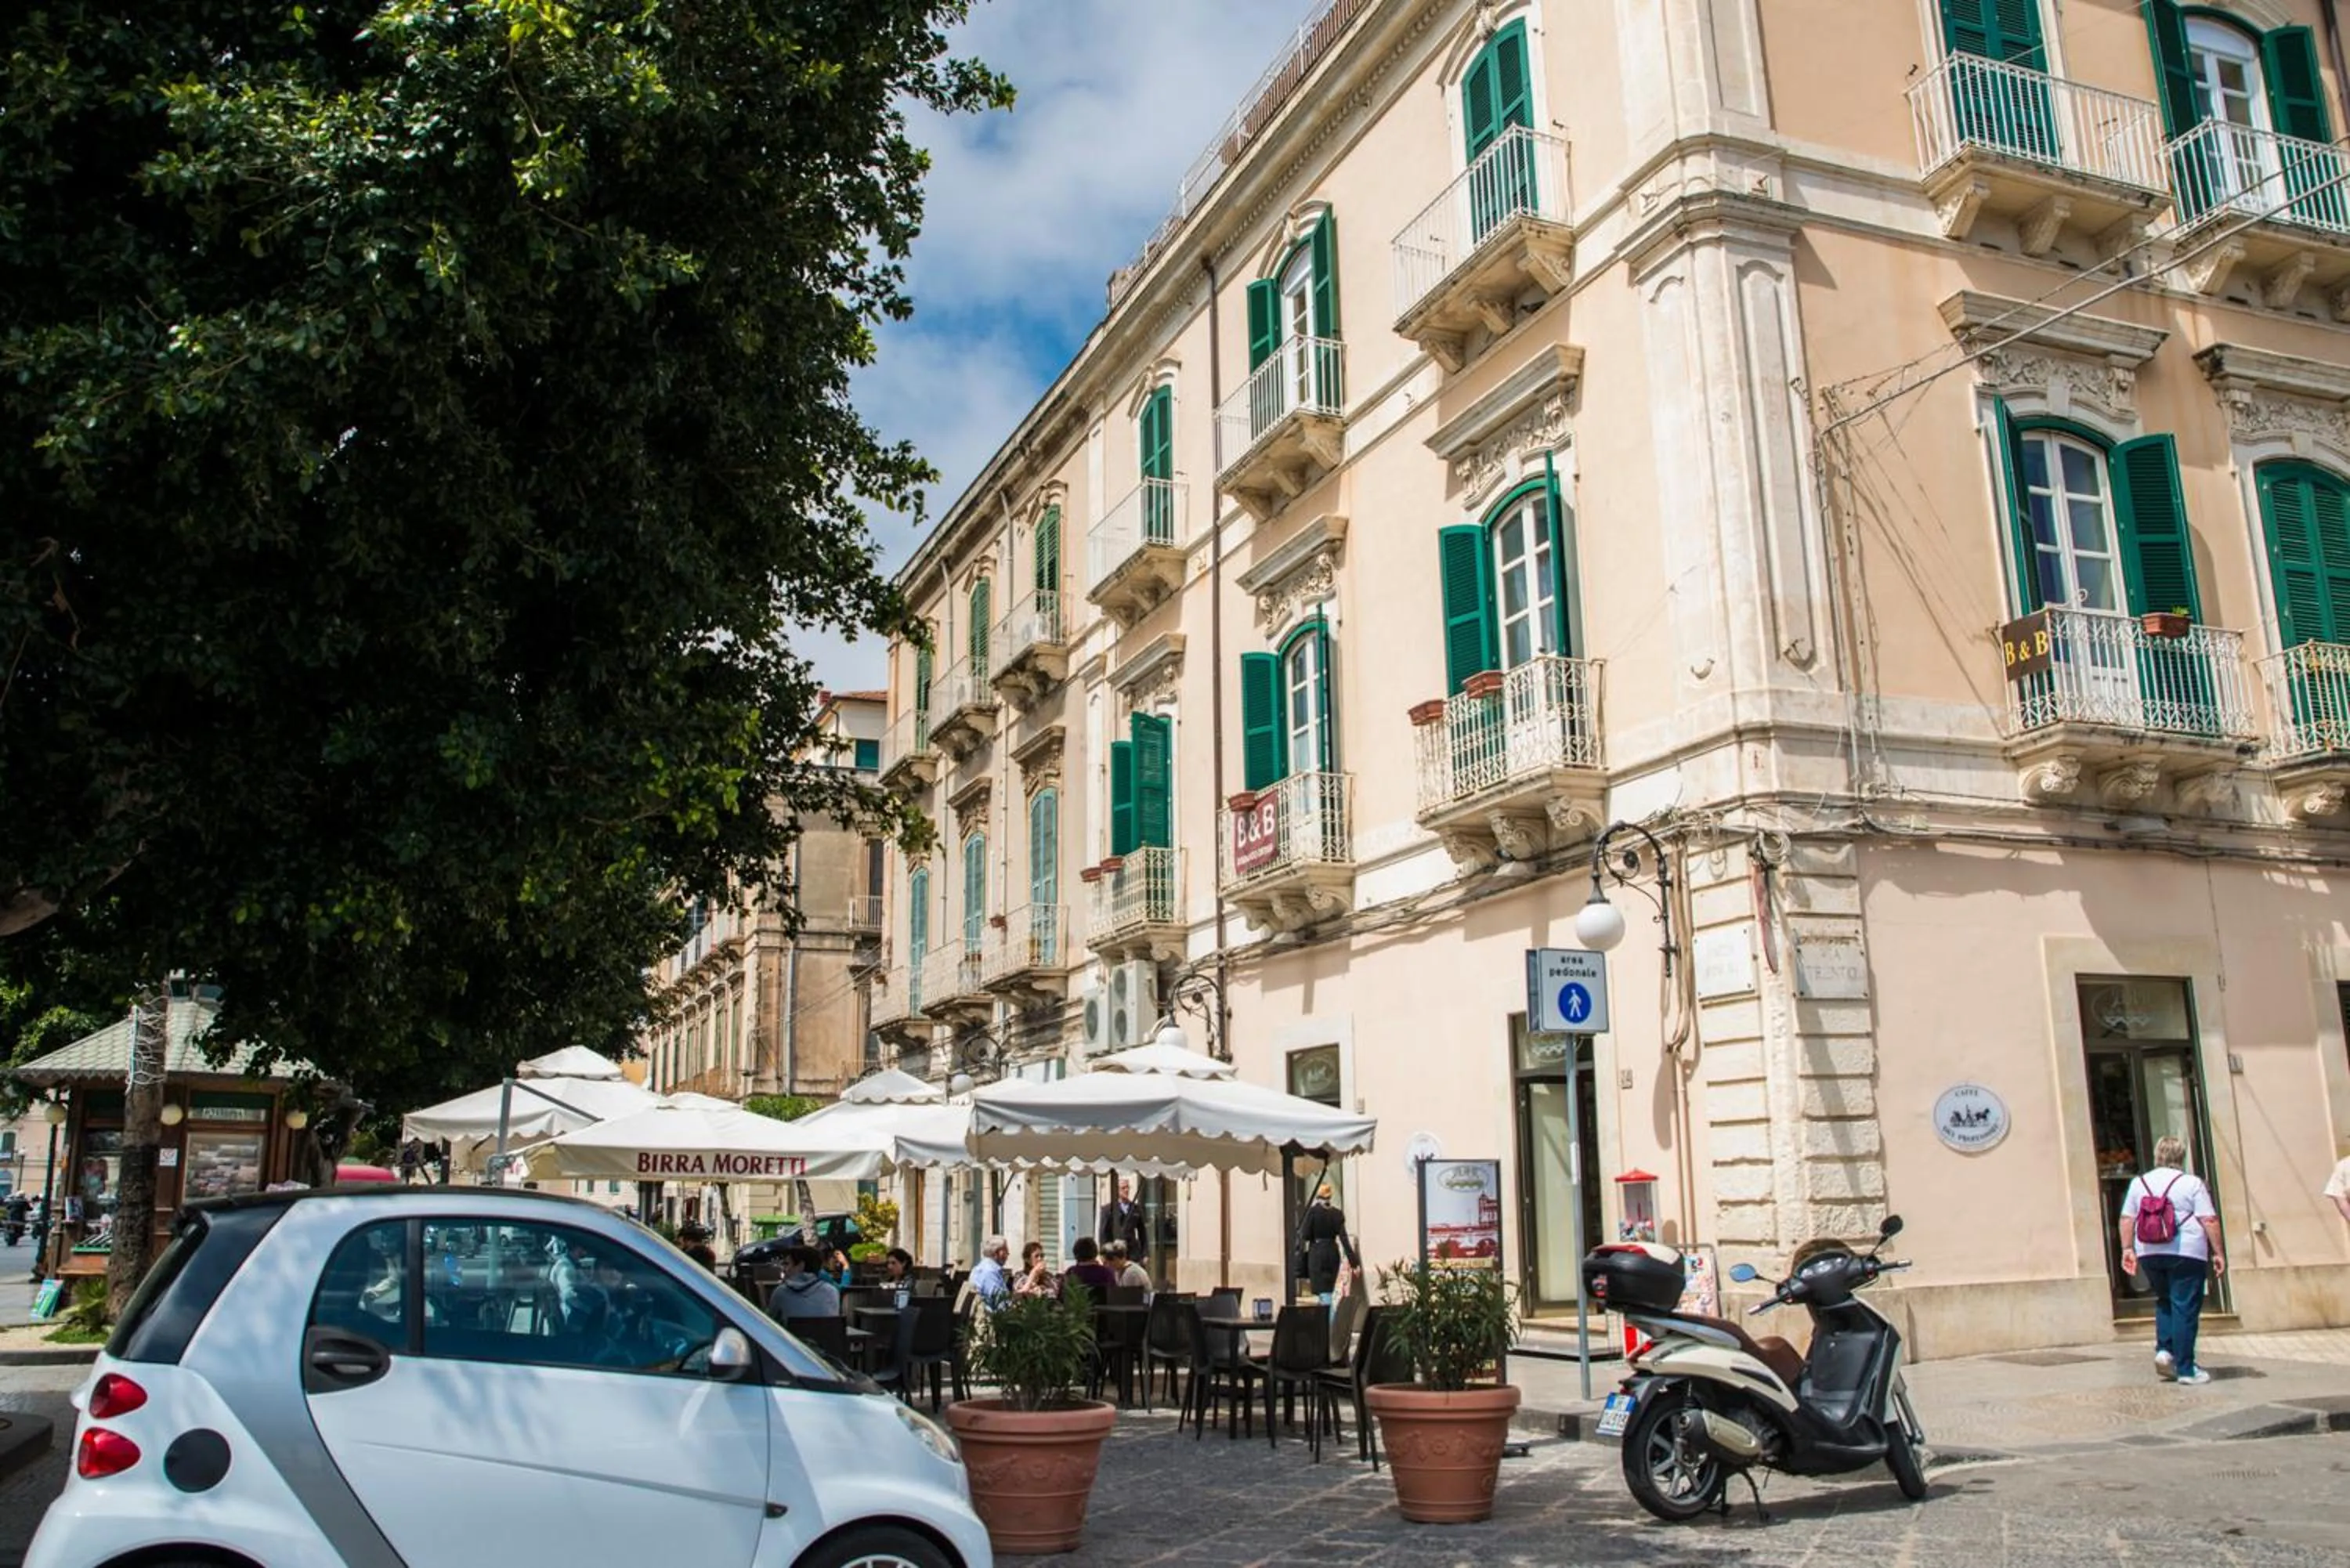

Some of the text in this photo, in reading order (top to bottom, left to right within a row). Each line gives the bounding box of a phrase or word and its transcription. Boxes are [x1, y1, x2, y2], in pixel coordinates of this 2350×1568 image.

[1560, 956, 1584, 964] area
[1549, 966, 1597, 977] pedonale
[637, 1151, 807, 1175] BIRRA MORETTI
